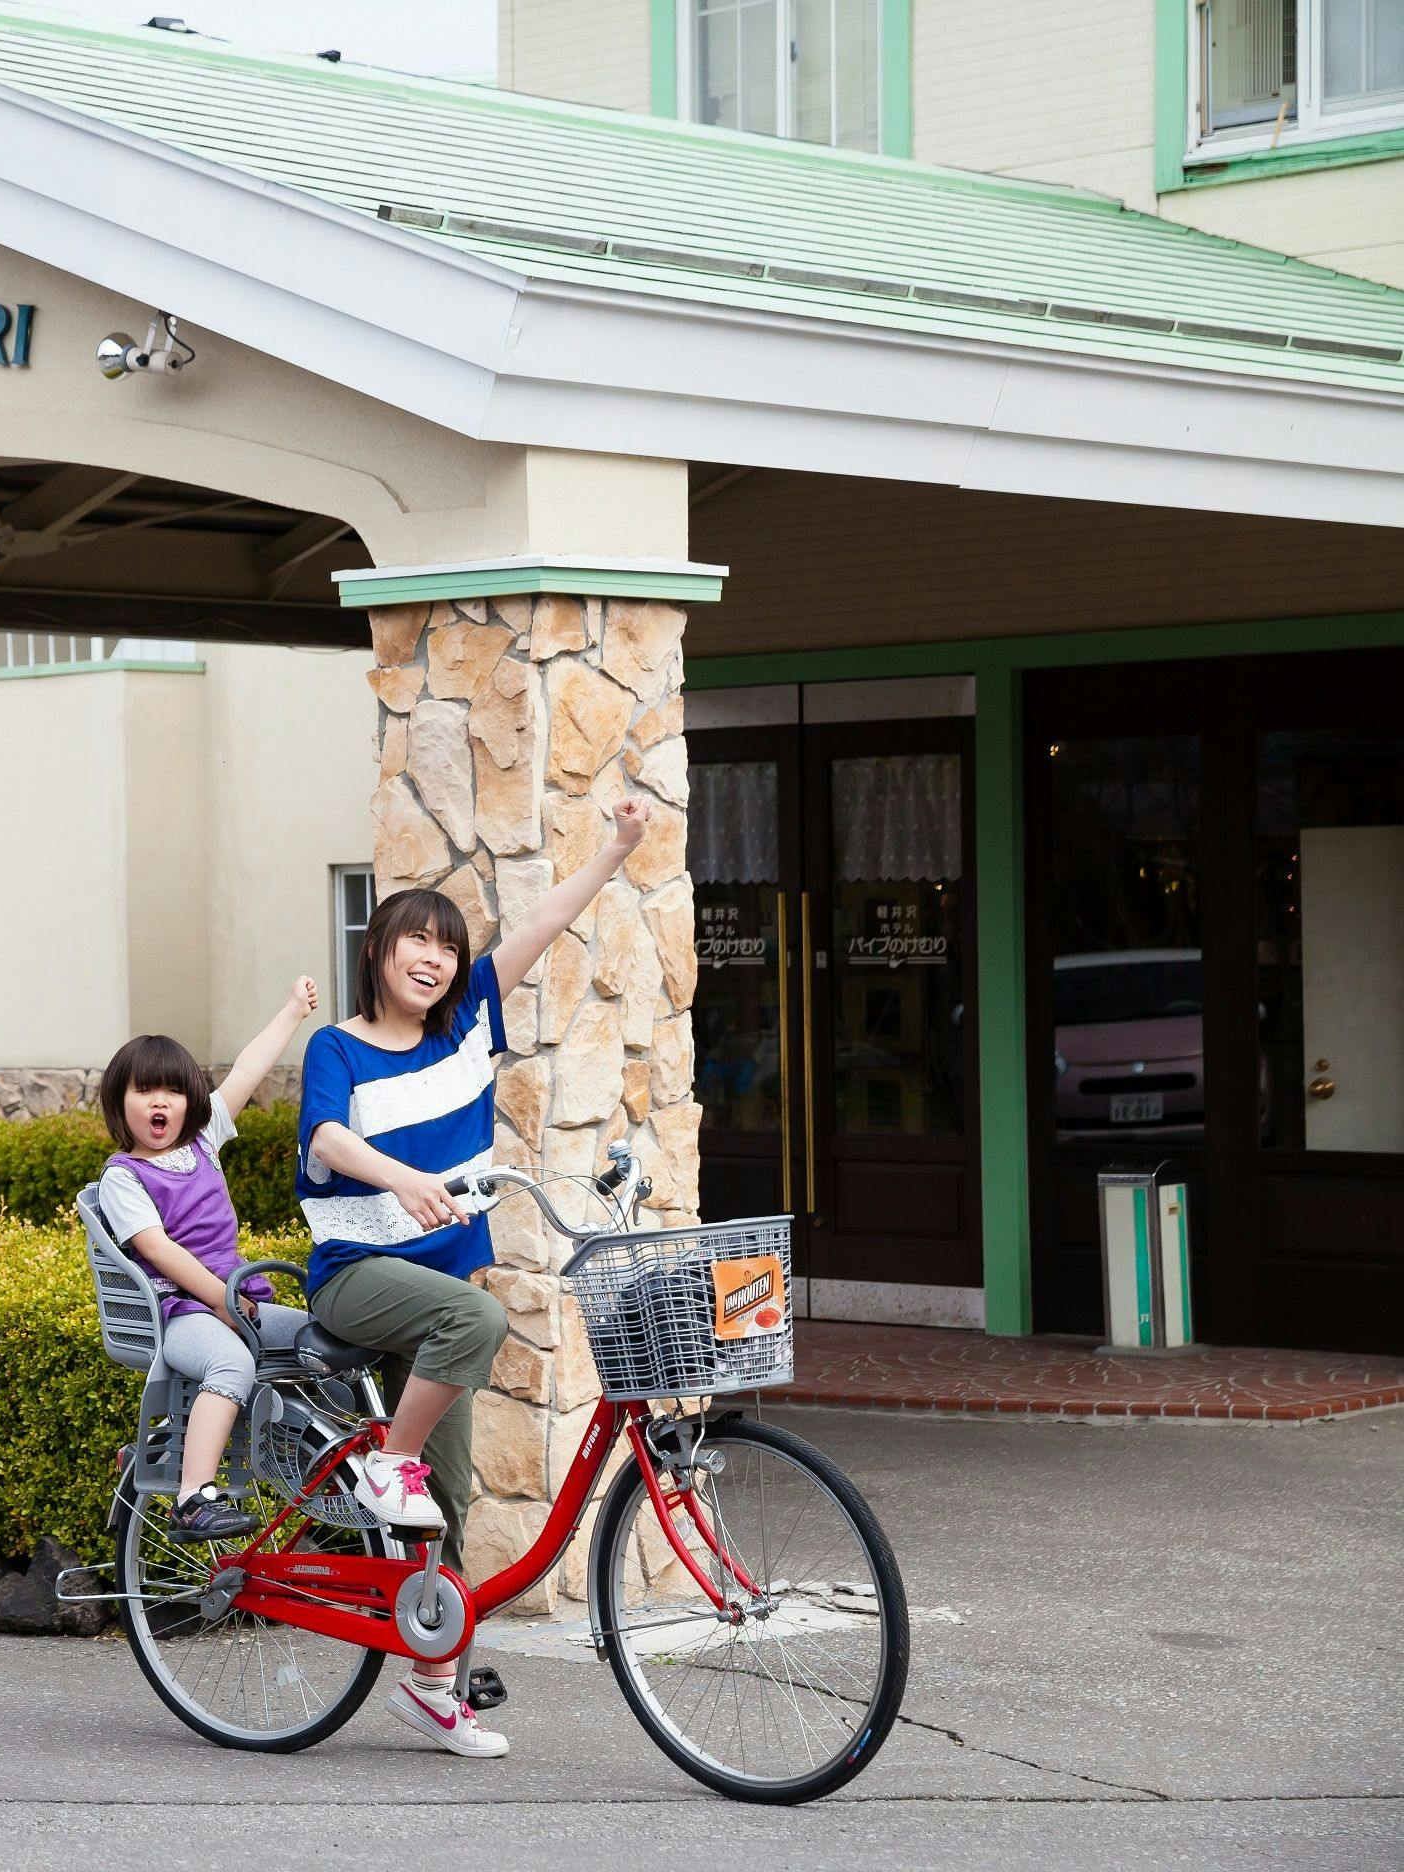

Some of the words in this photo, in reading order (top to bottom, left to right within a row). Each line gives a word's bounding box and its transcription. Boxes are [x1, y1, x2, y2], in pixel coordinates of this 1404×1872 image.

[701, 907, 738, 921] 軽井沢
[877, 905, 917, 919] 軽井沢
[705, 924, 735, 936] ホテル
[880, 922, 914, 934] ホテル
[694, 937, 765, 955] イプのけむり
[848, 936, 947, 954] パイプのけむり
[725, 1292, 738, 1311] VAN
[737, 1274, 770, 1309] HOUTEN
